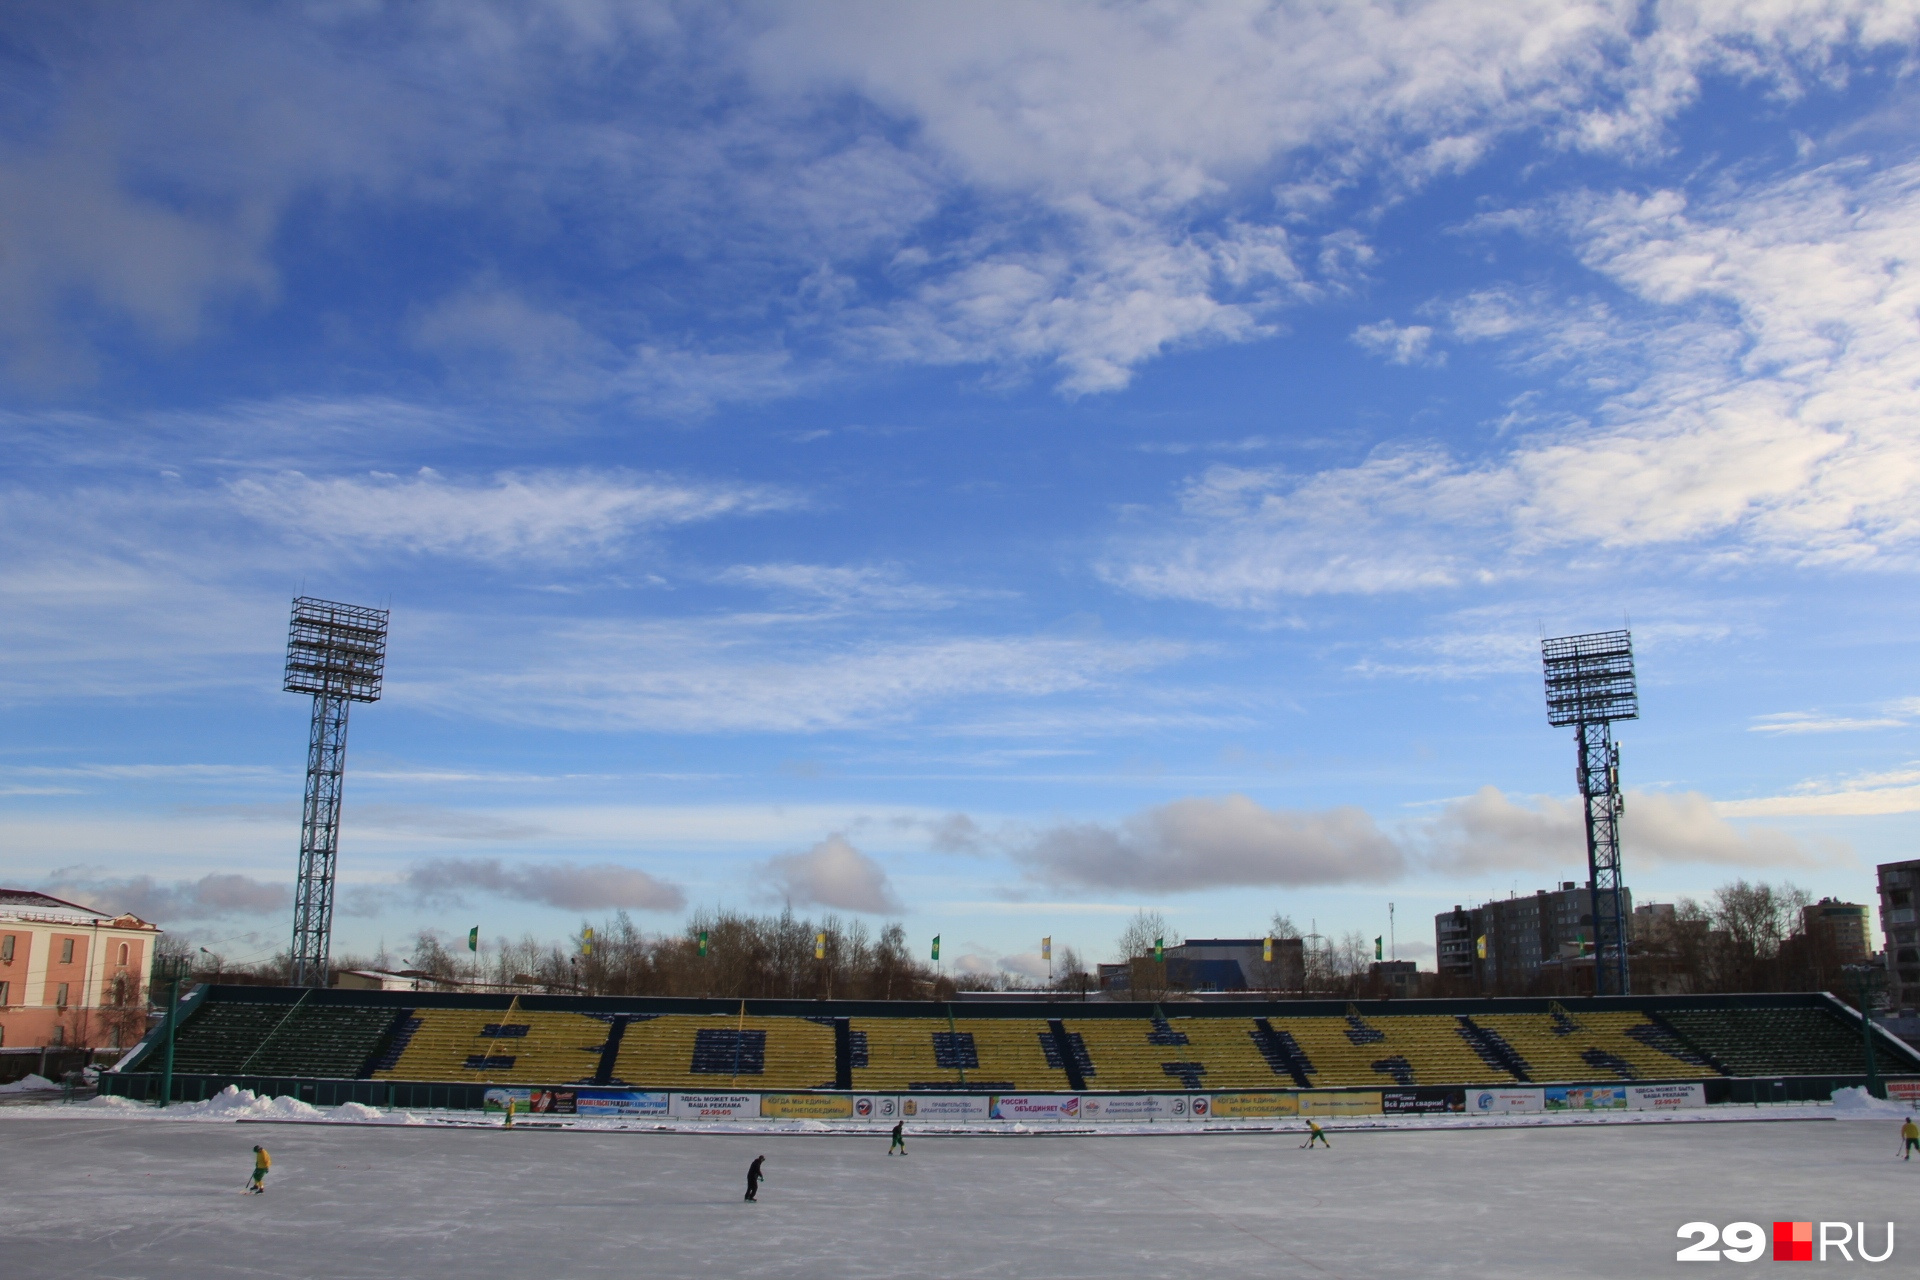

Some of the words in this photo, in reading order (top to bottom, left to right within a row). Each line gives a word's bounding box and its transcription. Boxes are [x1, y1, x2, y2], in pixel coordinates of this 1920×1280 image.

[1384, 1100, 1398, 1108] Всё
[1415, 1099, 1444, 1108] сварки!
[794, 1107, 847, 1115] НЕПОБЕДИМЫ!
[1014, 1105, 1058, 1113] ОБЪЕДИНЯЕТ
